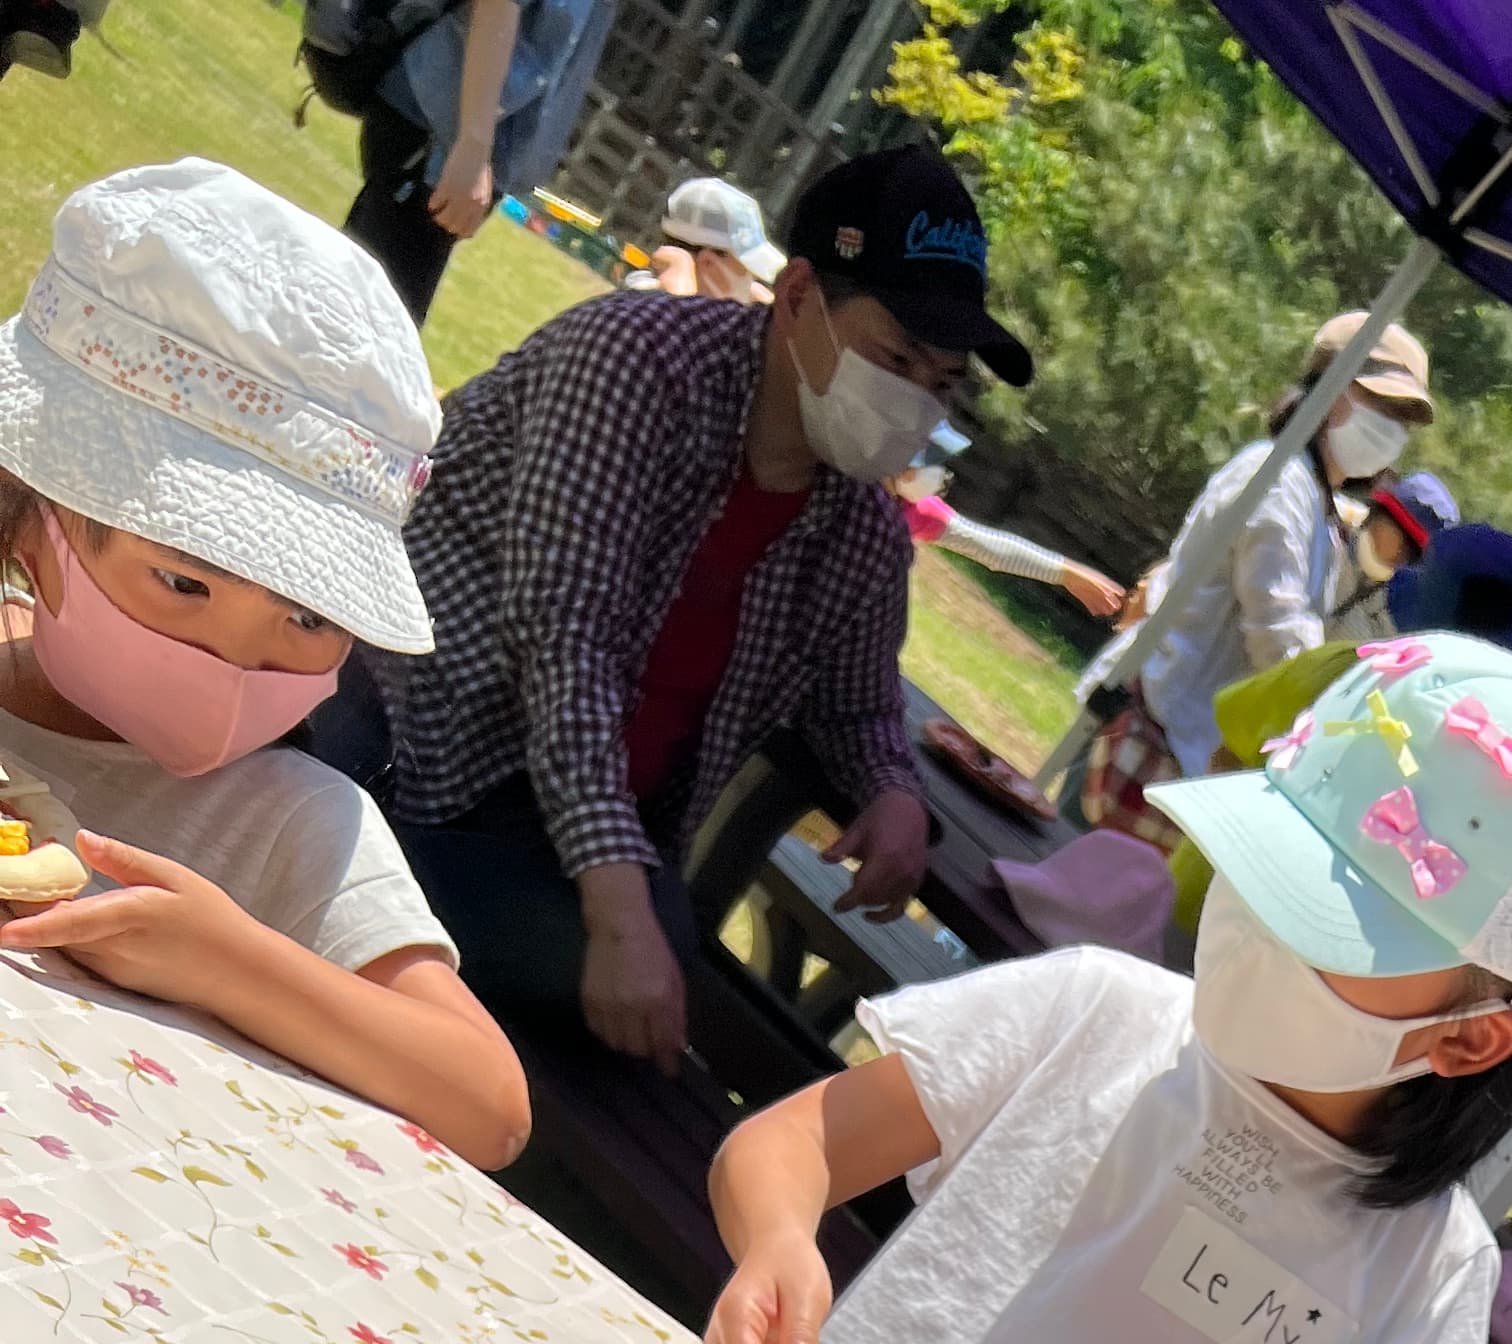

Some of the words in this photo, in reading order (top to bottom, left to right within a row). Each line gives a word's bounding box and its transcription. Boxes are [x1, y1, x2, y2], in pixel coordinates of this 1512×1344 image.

[1201, 1128, 1259, 1176] ALWAYS
[1261, 1174, 1283, 1195] BE
[1225, 1128, 1274, 1174] YOU'LL
[1242, 1124, 1279, 1158] WISH
[1201, 1165, 1242, 1200] WITH
[1202, 1147, 1259, 1193] FILLED
[1181, 1244, 1229, 1305] Le
